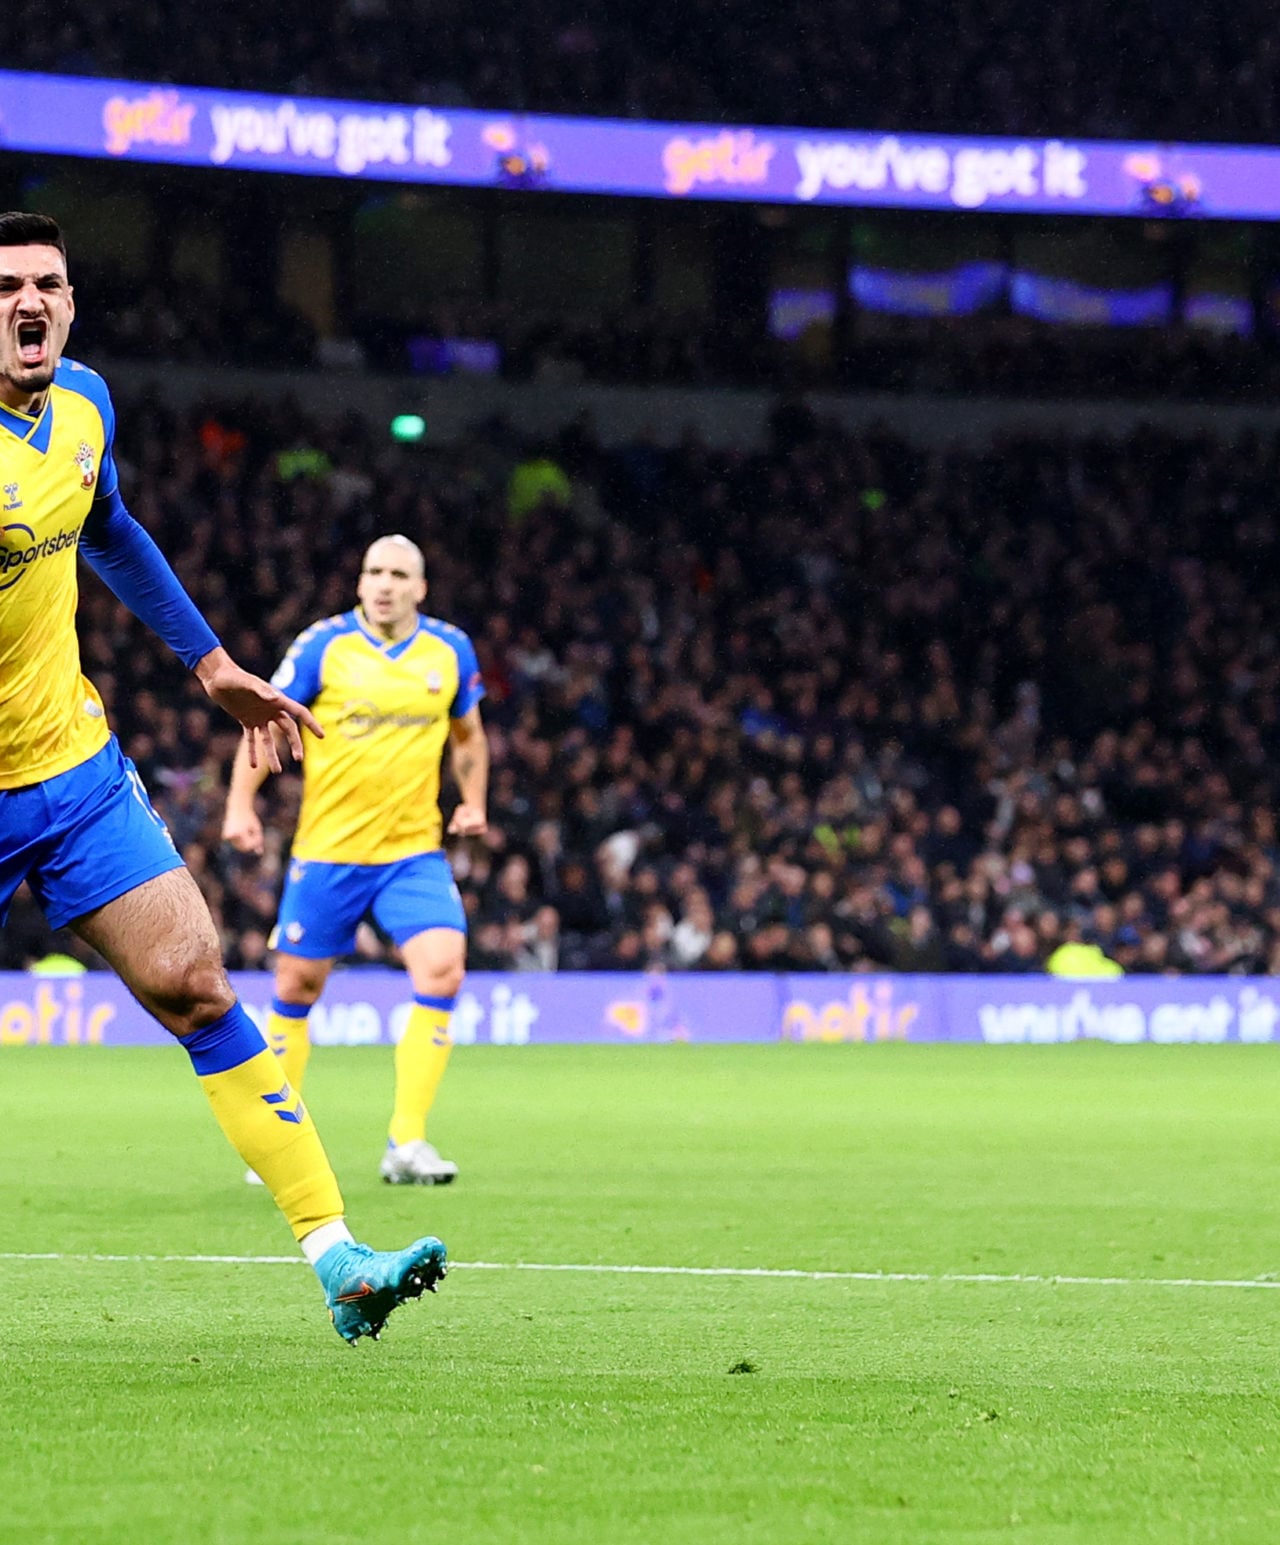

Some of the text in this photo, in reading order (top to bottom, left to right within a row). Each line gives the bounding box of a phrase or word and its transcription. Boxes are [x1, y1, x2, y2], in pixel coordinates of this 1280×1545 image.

[210, 100, 335, 164] you've
[336, 114, 409, 174] got
[413, 108, 451, 167] it
[795, 136, 951, 201] you've
[951, 145, 1037, 208] got
[1043, 140, 1086, 199] it
[490, 976, 539, 1046] it
